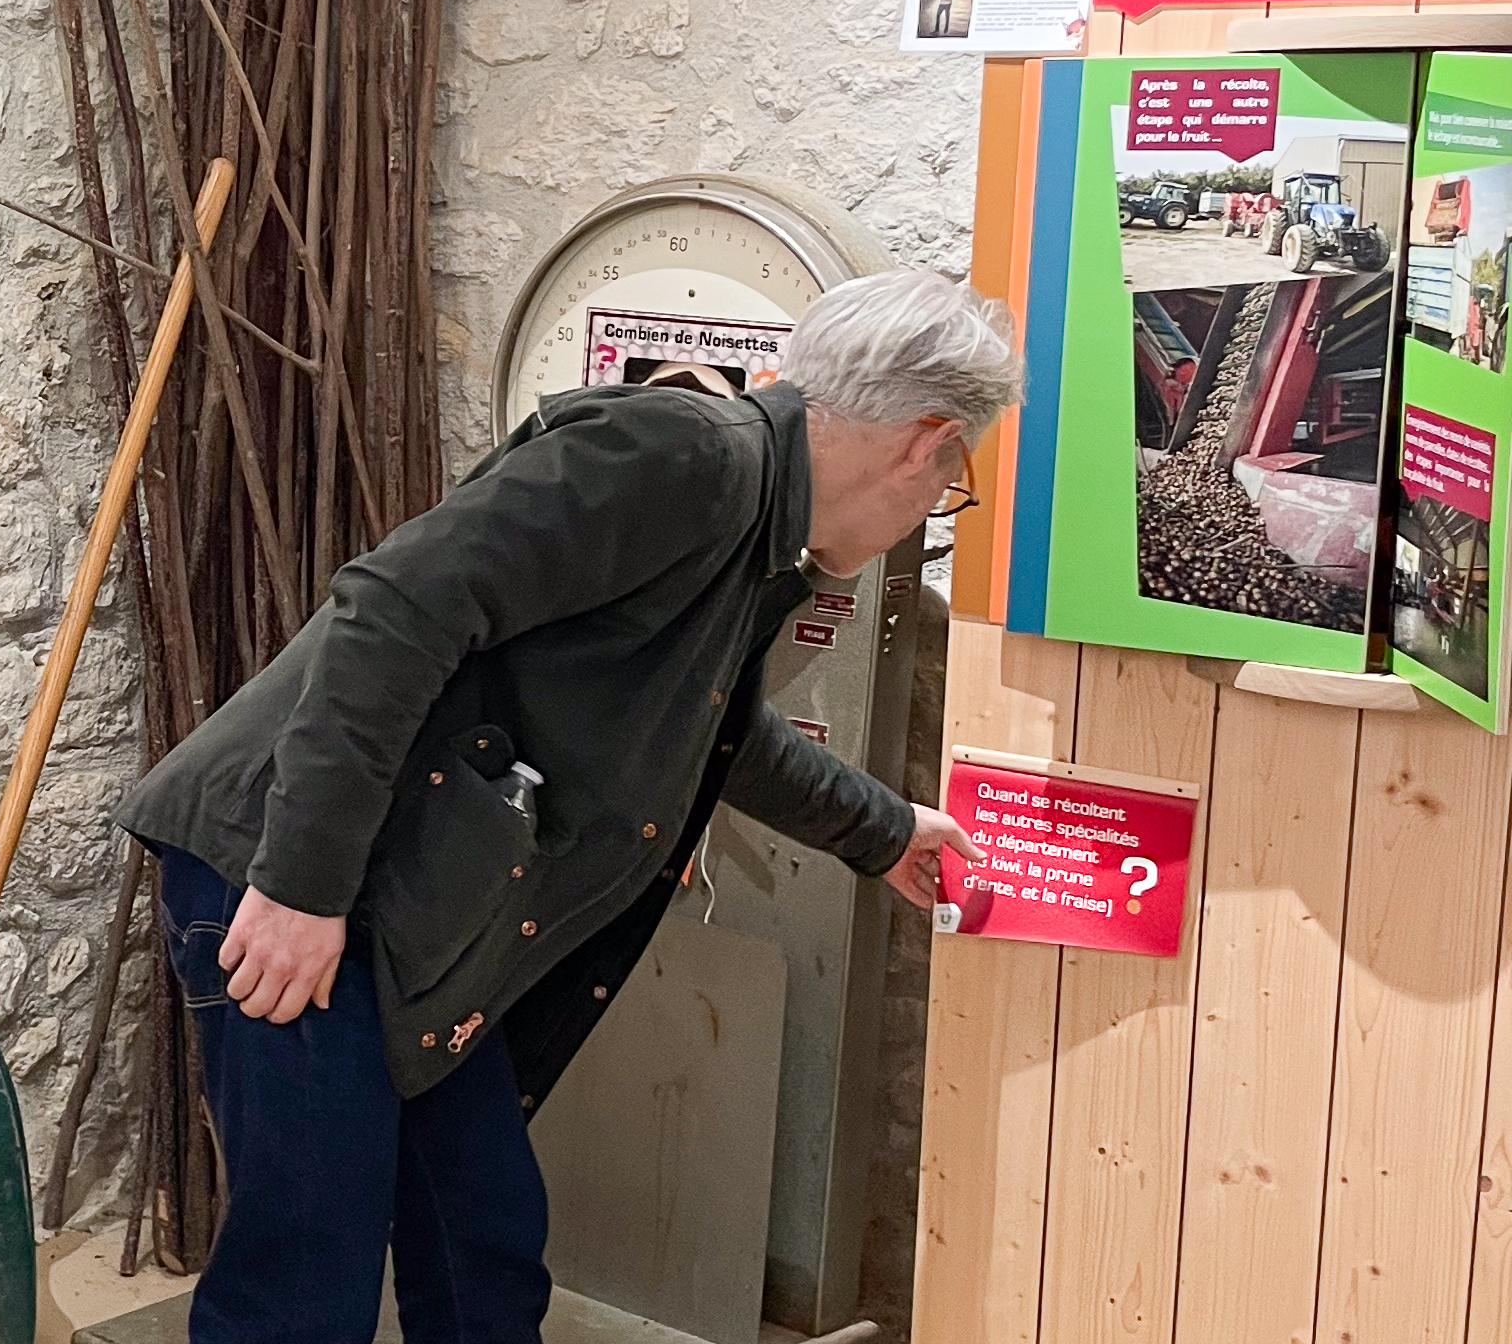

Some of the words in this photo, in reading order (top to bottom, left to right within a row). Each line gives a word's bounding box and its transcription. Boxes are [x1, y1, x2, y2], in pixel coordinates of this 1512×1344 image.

[1139, 79, 1178, 93] Après
[1193, 79, 1205, 91] la
[1220, 78, 1269, 92] récolte,
[1138, 97, 1169, 109] c'est
[1188, 97, 1213, 108] une
[1233, 97, 1268, 108] autre
[1137, 113, 1173, 127] étape
[1182, 113, 1202, 127] qui
[1212, 112, 1267, 125] démarre
[1135, 131, 1165, 145] pour
[1167, 131, 1179, 142] le
[670, 237, 688, 251] 60
[603, 266, 619, 280] 55
[761, 264, 770, 278] 5
[558, 327, 573, 341] 50
[605, 324, 668, 343] Combien
[675, 330, 692, 344] de
[700, 332, 778, 352] Noisettes
[597, 344, 617, 370] ?
[978, 782, 1028, 805] Quand
[1031, 795, 1050, 808] se
[1054, 797, 1126, 822] récoltent
[975, 806, 998, 822] les
[1002, 810, 1052, 832] autres
[1056, 821, 1139, 847] spécialités
[972, 829, 992, 845] du
[996, 834, 1099, 864] département
[991, 854, 1023, 876] kiwi,
[1028, 862, 1041, 877] la
[1045, 868, 1093, 886] prune
[964, 875, 1016, 899] d'ente,
[1021, 887, 1039, 900] et
[1042, 888, 1056, 904] la
[1060, 891, 1113, 917] fraise)
[1120, 856, 1158, 914] ?
